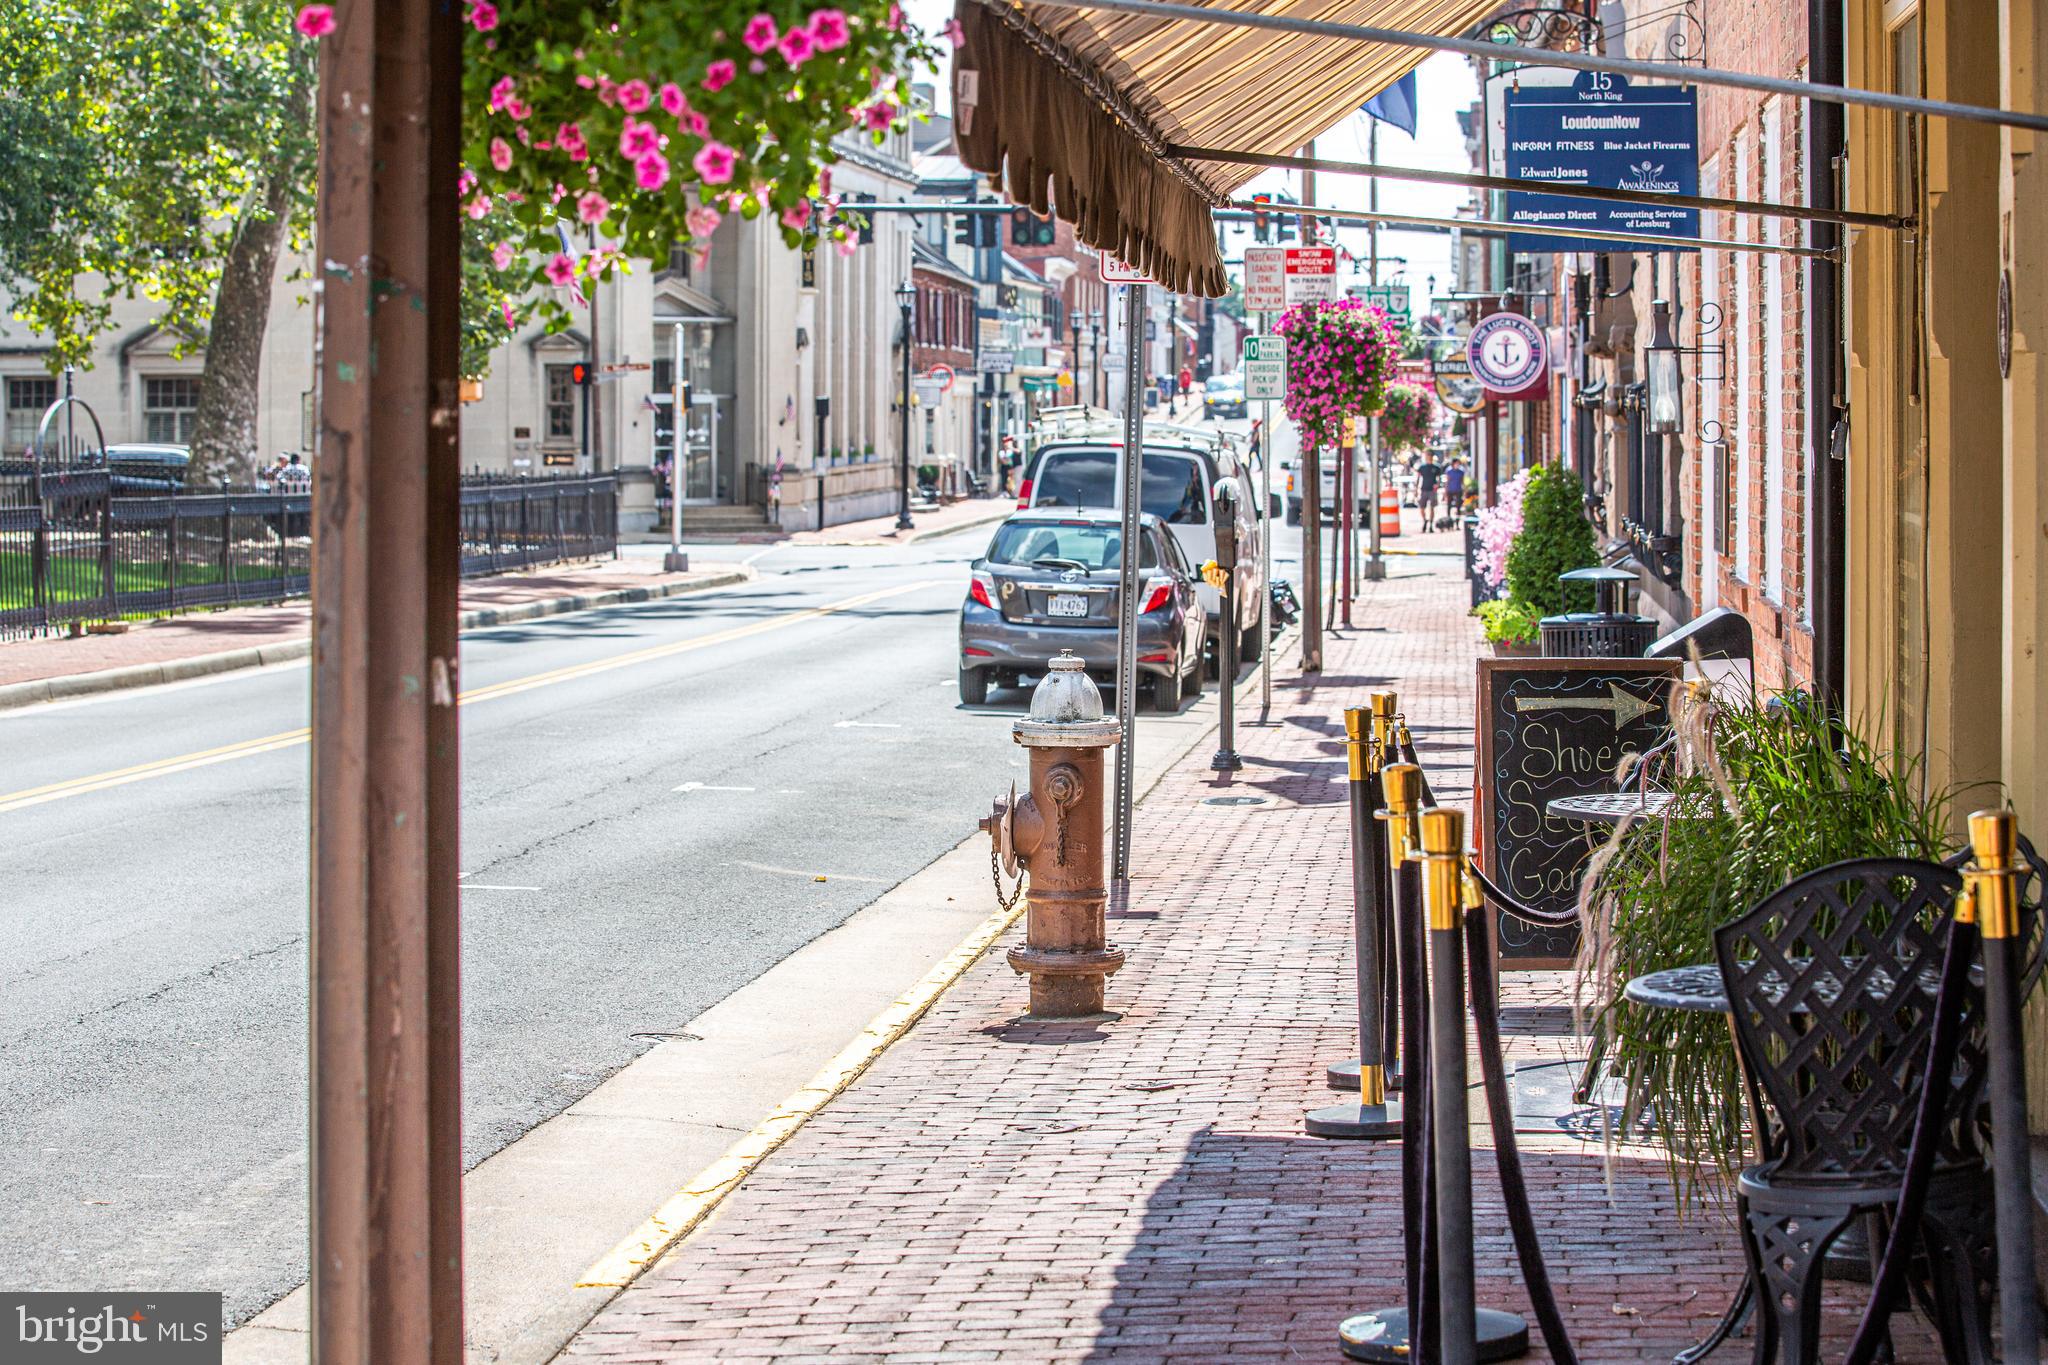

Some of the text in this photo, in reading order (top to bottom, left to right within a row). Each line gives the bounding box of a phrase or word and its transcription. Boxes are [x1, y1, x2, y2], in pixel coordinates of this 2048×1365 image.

[1590, 71, 1612, 91] 15
[1578, 91, 1622, 101] North King
[1561, 115, 1640, 129] LoudounNow
[1512, 141, 1594, 151] INFORM FITNESS
[1604, 141, 1690, 150] Blue Jacket Firearms
[1617, 178, 1679, 190] AWAKENINGS
[1513, 211, 1597, 221] Allegiance Direct
[1609, 210, 1687, 219] Accounting Services
[1626, 220, 1670, 229] of Leesburg
[1298, 250, 1321, 258] SNOW
[1109, 261, 1115, 272] 5
[1287, 258, 1333, 266] EMERGENCY
[1252, 264, 1277, 272] LOADING
[1257, 275, 1272, 283] ZONE
[1248, 286, 1256, 294] NO
[1474, 319, 1538, 345] THE LUCKY KNOT
[1244, 341, 1258, 358] 10
[1249, 364, 1280, 373] CURBSIDE
